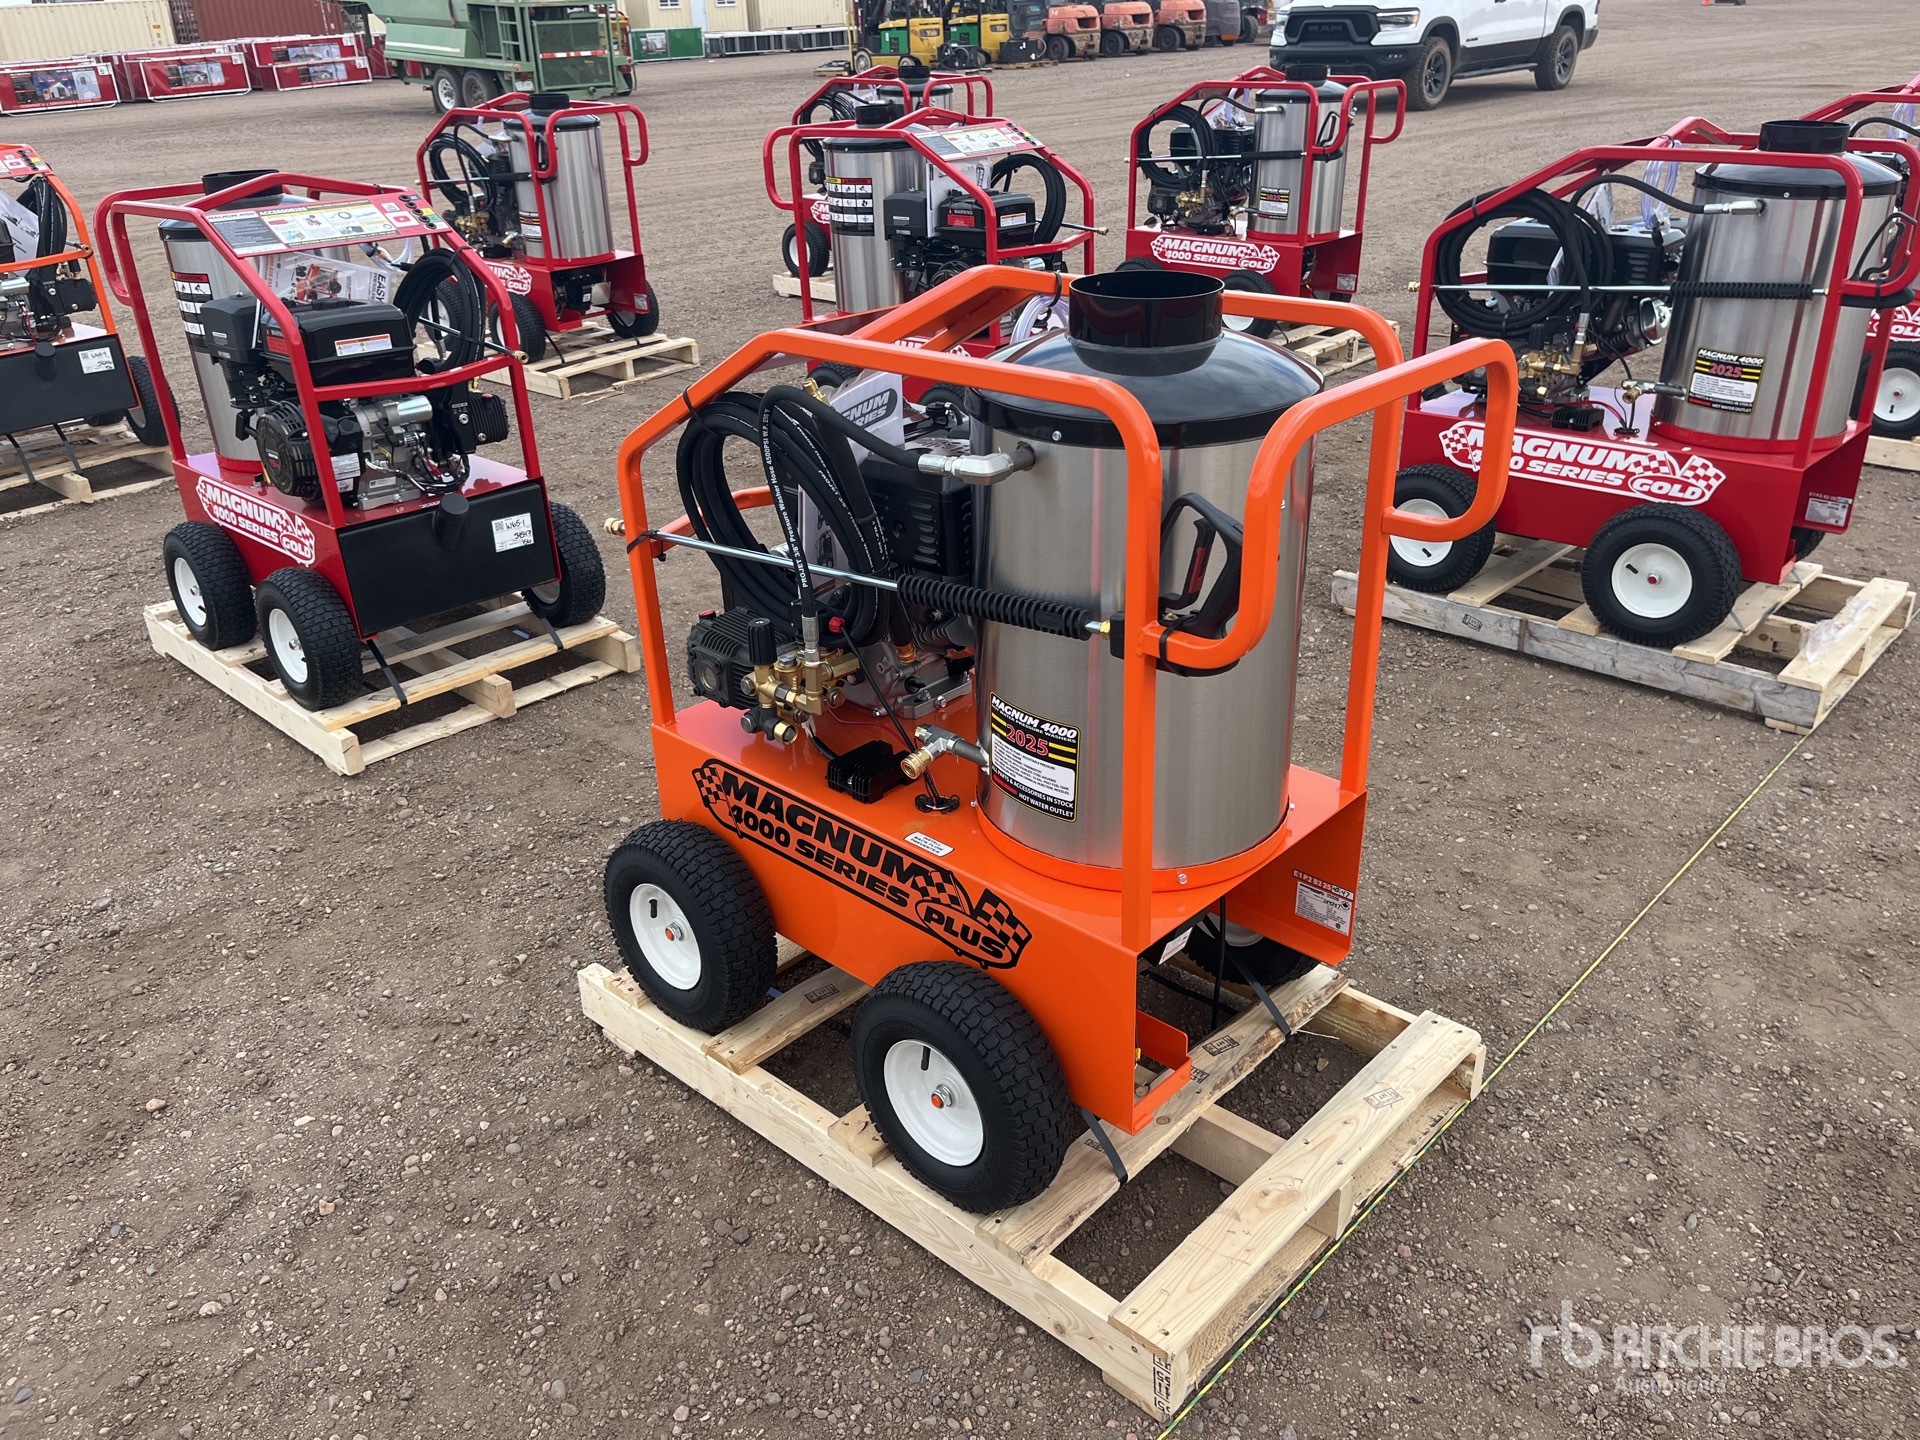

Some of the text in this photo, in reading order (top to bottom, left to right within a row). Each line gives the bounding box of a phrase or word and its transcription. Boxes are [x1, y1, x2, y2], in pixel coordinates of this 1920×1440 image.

[260, 206, 308, 216] ACCESSORIES
[1164, 238, 1243, 257] MAGNUM
[1166, 250, 1270, 269] 4000 SERIES GOLD
[508, 281, 528, 290] GOLD
[1698, 349, 1764, 364] MAGNUM 4000
[1709, 363, 1742, 378] 2025
[763, 438, 772, 465] 4500PSI
[769, 466, 777, 484] Hose
[1467, 450, 1702, 500] 40 SERIES GOLD
[206, 484, 280, 531] MAGNUM
[774, 484, 786, 511] Washer
[213, 504, 311, 559] 4000 SERIES GOLD
[783, 511, 796, 542] Pressure
[796, 559, 808, 588] PROJET
[992, 696, 1077, 738] MAGNUM 4000
[1006, 724, 1048, 756] 2025
[1016, 720, 1043, 734] PRESSURE
[1045, 732, 1076, 743] WASHERS
[998, 771, 1009, 784] PARTS
[1014, 781, 1046, 800] ACCESSORIES
[1054, 798, 1074, 808] STOCK
[1019, 792, 1074, 818] HOT WATER OUTLET
[720, 770, 925, 889] MAGNUM
[728, 804, 1006, 960] 4000 SERIES PLUS
